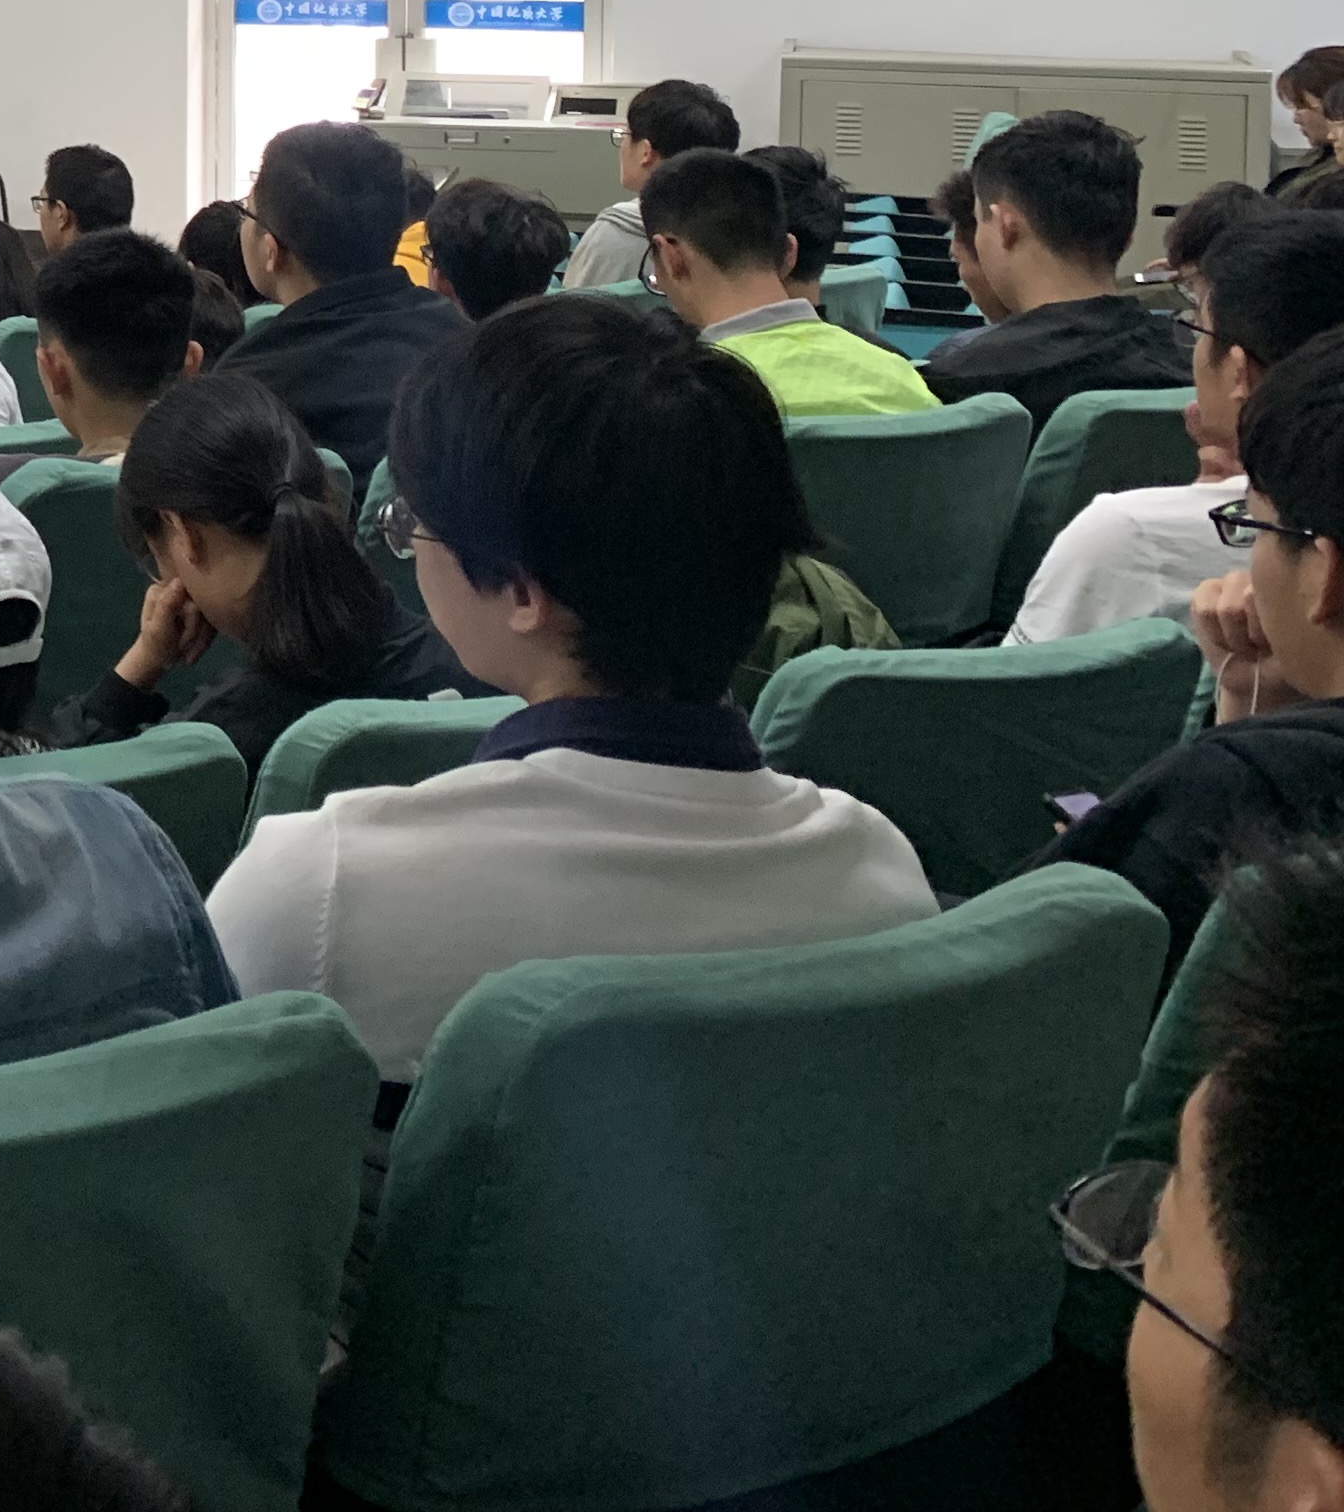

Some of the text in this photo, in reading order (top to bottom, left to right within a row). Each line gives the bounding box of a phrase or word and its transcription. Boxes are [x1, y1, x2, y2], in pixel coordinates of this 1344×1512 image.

[284, 2, 368, 17] 中国地质大学
[476, 5, 564, 21] 中国地质大学
